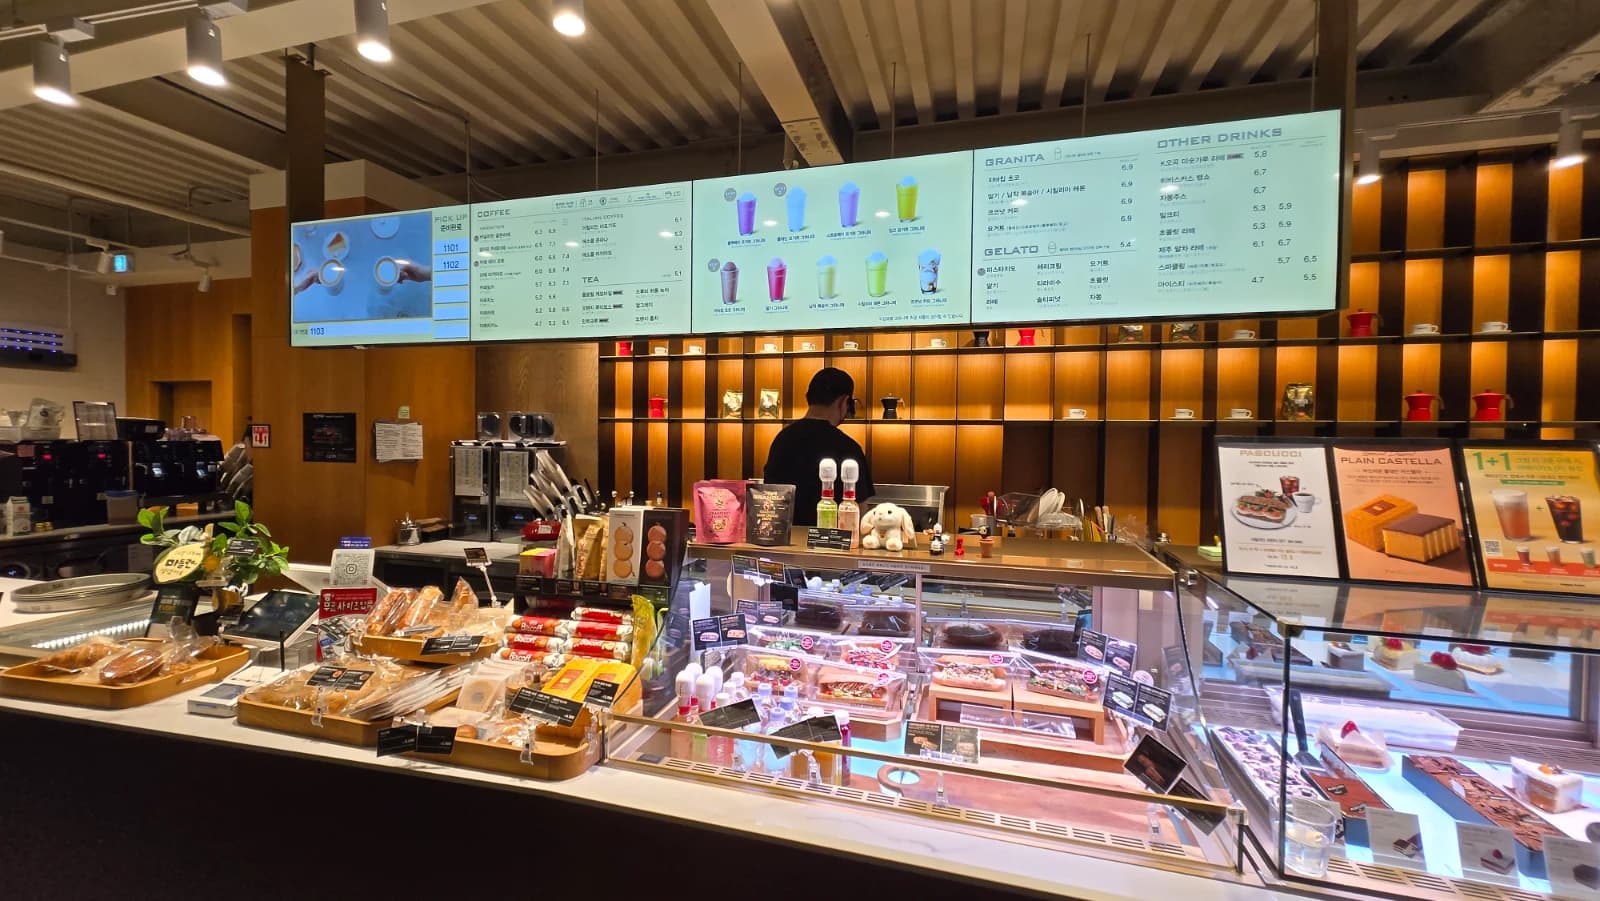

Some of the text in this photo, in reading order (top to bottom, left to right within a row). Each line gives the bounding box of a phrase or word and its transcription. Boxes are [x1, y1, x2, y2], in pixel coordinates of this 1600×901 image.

[1157, 128, 1282, 149] OTHER DRINKS
[985, 154, 1045, 166] GRANITA
[477, 209, 511, 218] COFFEE
[443, 244, 459, 252] 1101
[984, 245, 1039, 256] GELATO
[443, 260, 460, 269] 1102
[310, 327, 325, 335] 1103
[1472, 452, 1512, 471] 1+1
[520, 622, 544, 632] Biscoff
[509, 652, 531, 662] Biscoff
